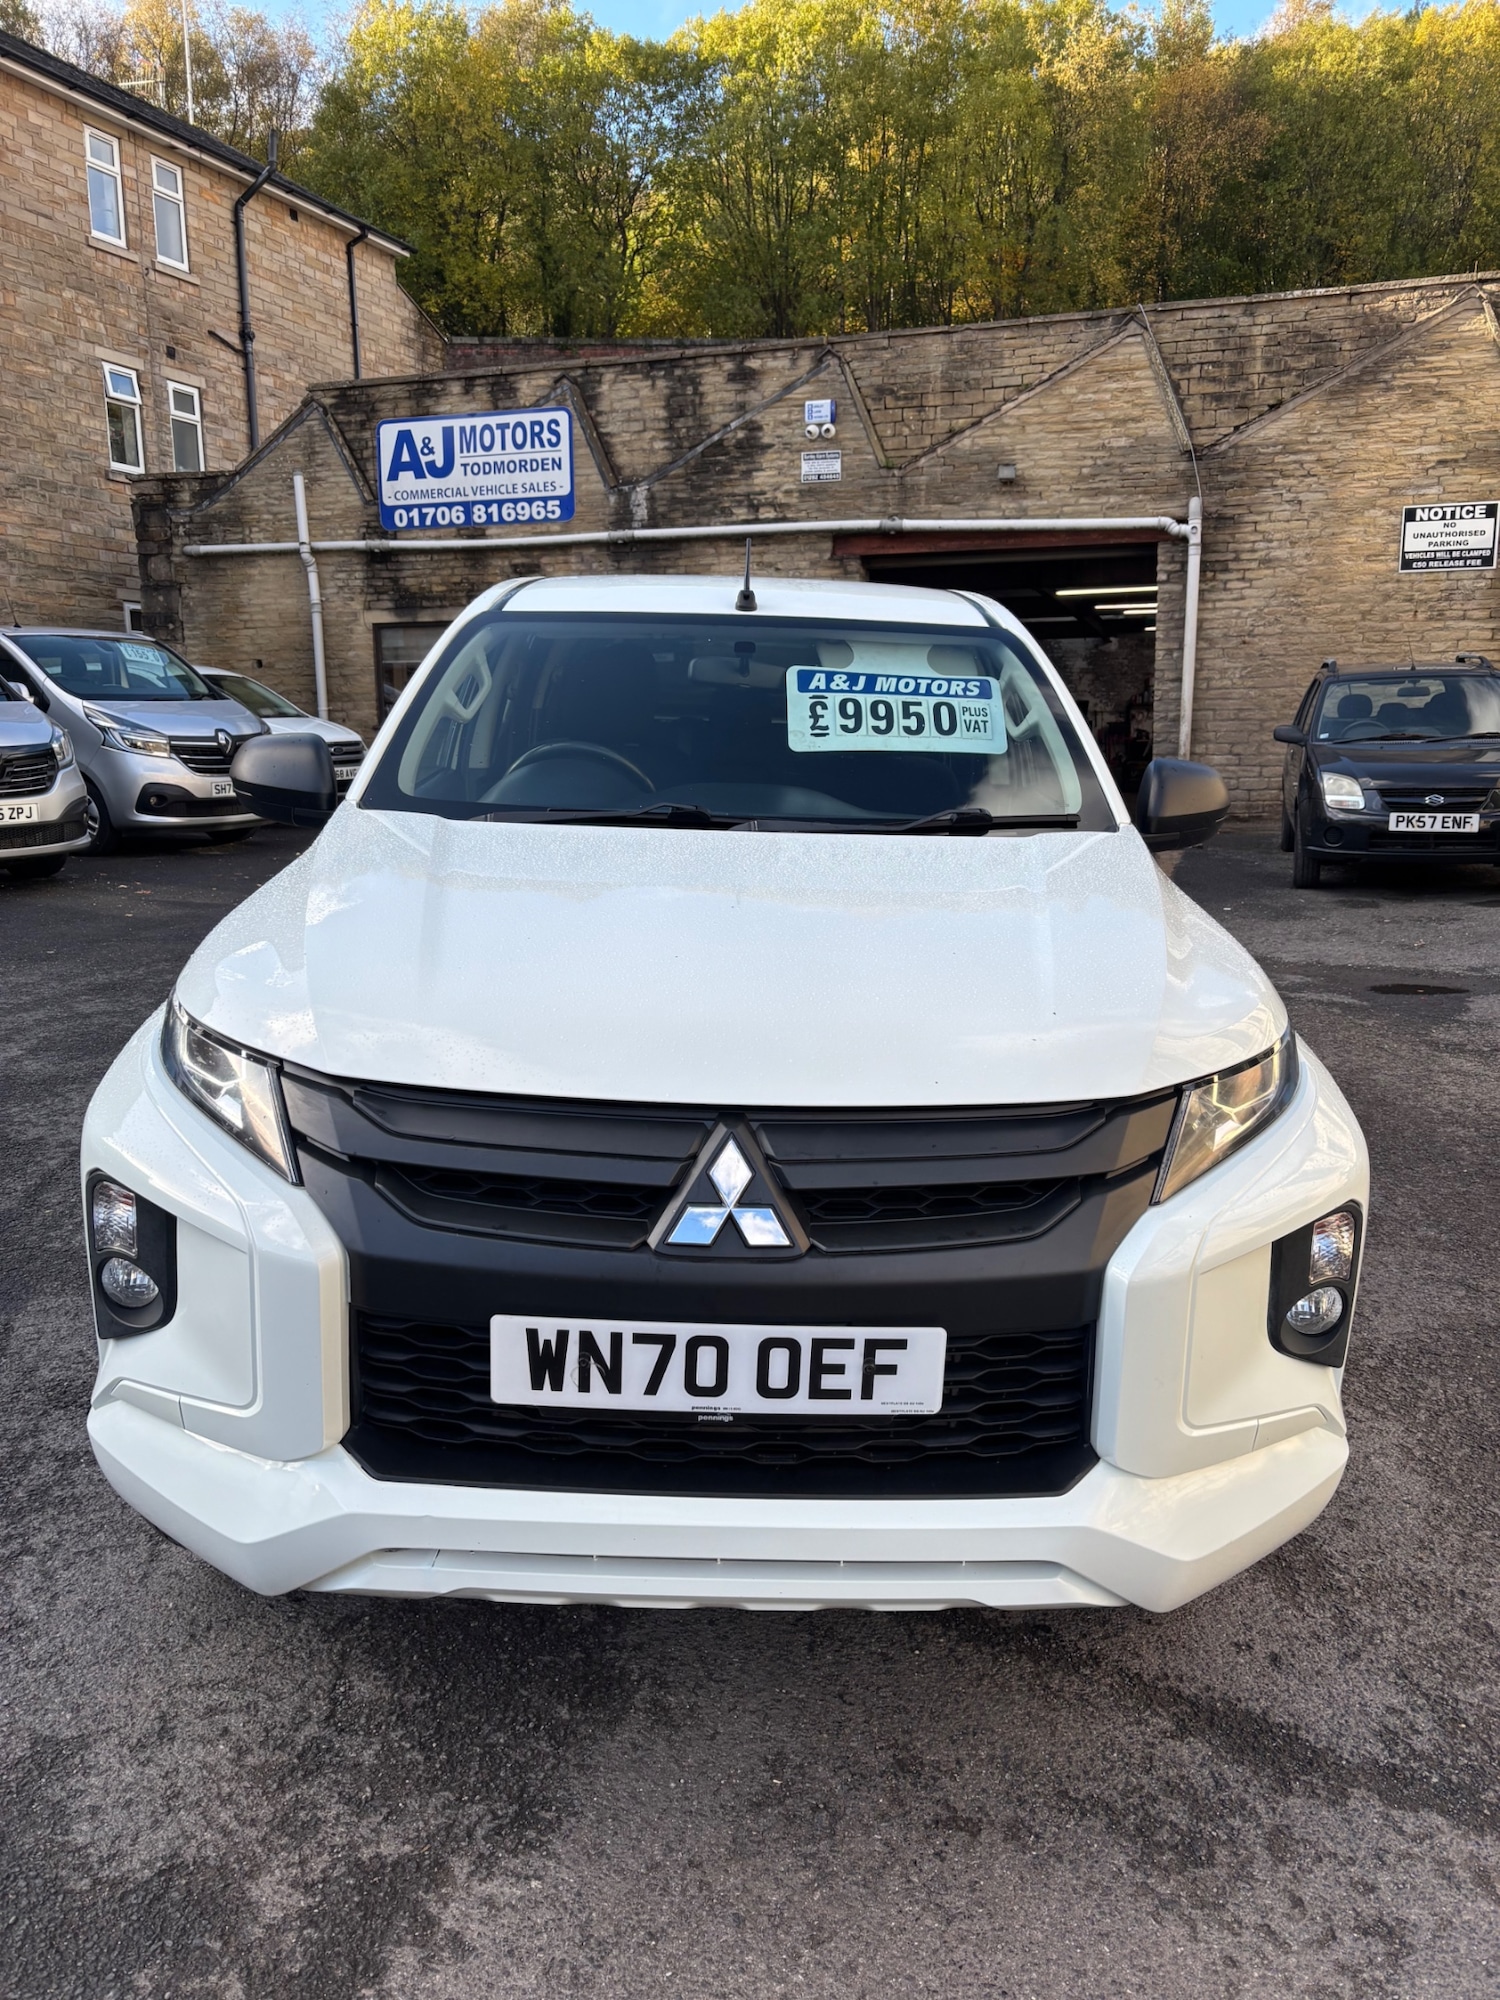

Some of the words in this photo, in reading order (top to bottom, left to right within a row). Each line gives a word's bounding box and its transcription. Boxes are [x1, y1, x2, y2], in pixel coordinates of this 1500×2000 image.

[459, 418, 562, 454] MOTORS
[461, 457, 563, 477] TODMORDEN
[394, 486, 469, 501] COMMERCIAL
[471, 483, 518, 497] VEHICLE
[521, 481, 556, 494] SALES
[394, 505, 465, 527] 01706
[472, 500, 561, 523] 816965
[1415, 505, 1487, 521] NOTICE
[1413, 530, 1486, 539] UNAUTHORISED
[1428, 540, 1469, 548] PARKING
[1404, 551, 1435, 559] VEHICLES
[1436, 551, 1451, 559] WILL
[1452, 550, 1461, 558] BE
[1462, 549, 1491, 557] CLAMPED
[1428, 560, 1465, 568] RELEASE
[808, 672, 866, 691] A&J
[875, 676, 980, 696] MOTORS
[962, 706, 988, 718] PLUS
[964, 719, 989, 733] VAT
[8, 806, 33, 820] ZPJ
[1395, 815, 1437, 829] PK57
[1441, 816, 1473, 829] ENF
[525, 1327, 729, 1398] WN70
[756, 1336, 908, 1400] OEF
